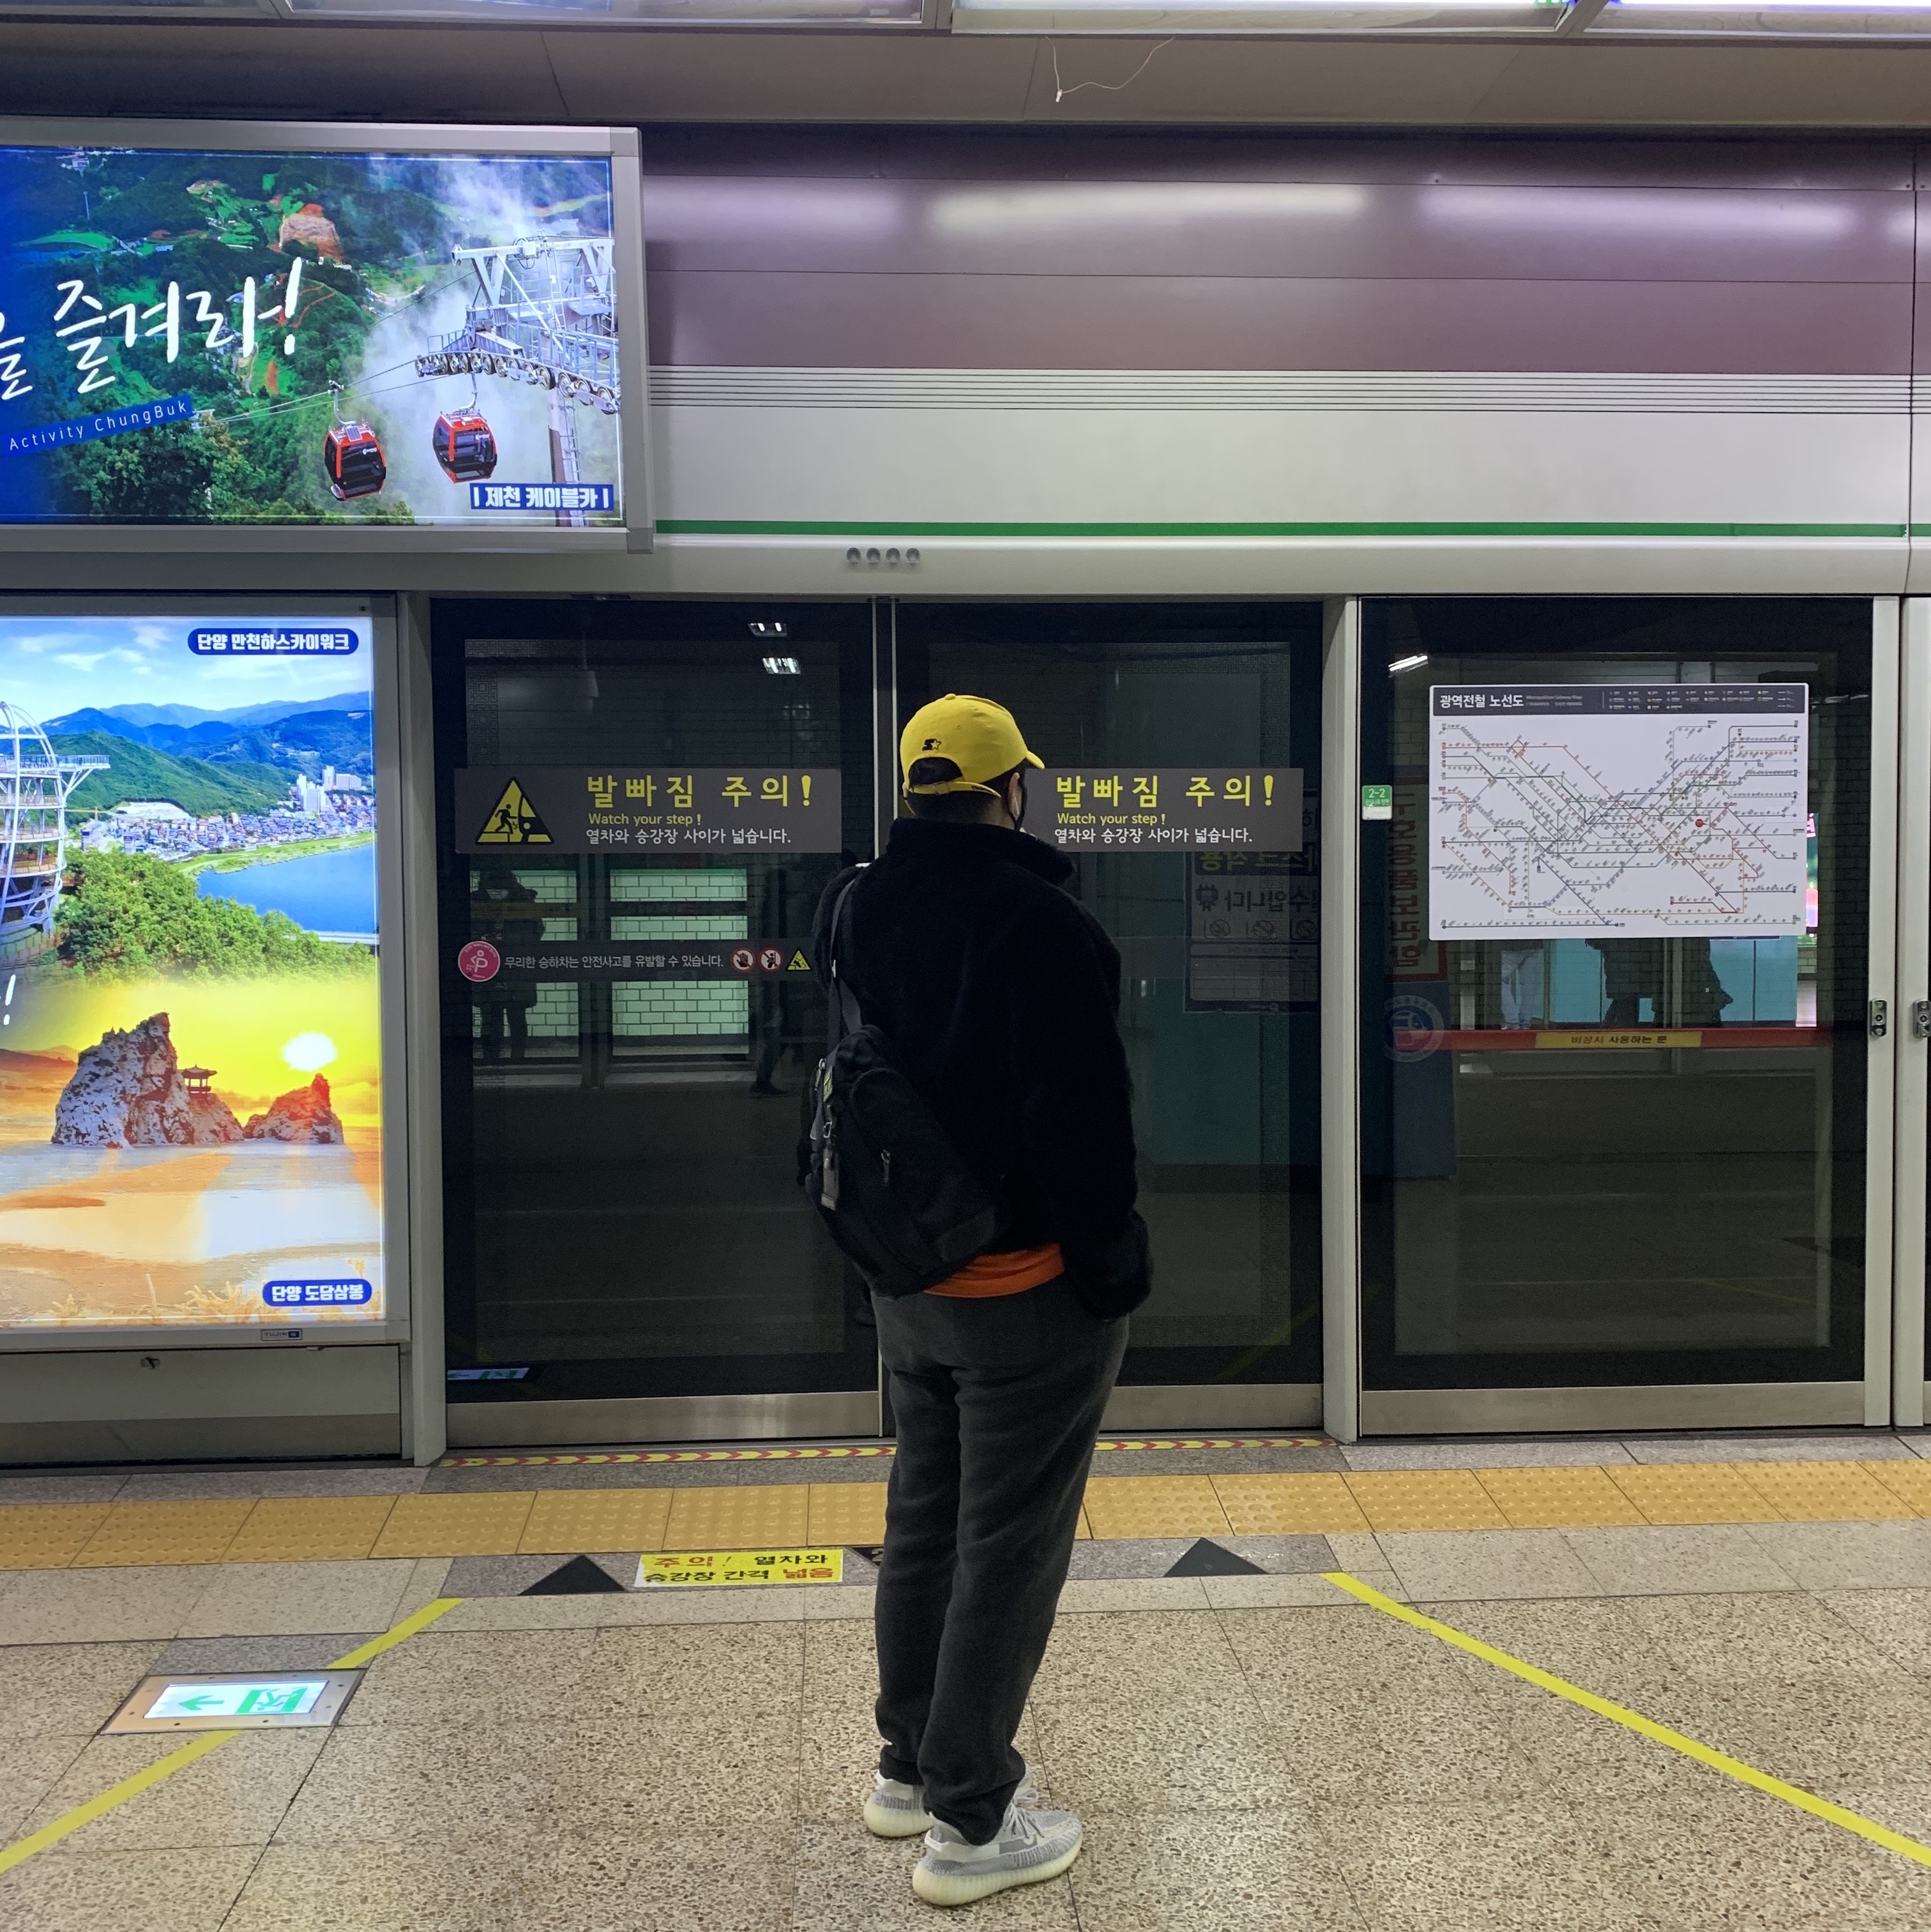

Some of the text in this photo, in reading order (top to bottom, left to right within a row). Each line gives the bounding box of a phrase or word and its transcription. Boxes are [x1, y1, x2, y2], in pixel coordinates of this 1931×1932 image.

[54, 256, 303, 394] 즐겨라!
[9, 400, 187, 451] Activity ChungBuk
[485, 485, 598, 508] 제천 케이블카
[197, 632, 350, 650] 단양 만천하스카이워크
[1440, 694, 1524, 708] 광역전철 노선도
[587, 775, 693, 808] 발빠짐
[1056, 775, 1158, 808] 발빠짐
[1368, 787, 1386, 798] 2-2
[588, 813, 629, 825] Watch
[633, 815, 662, 826] your
[1057, 812, 1096, 825] Watch
[1100, 815, 1128, 826] your
[586, 828, 791, 844] 열차와 승강장 사이가 넓습니다.
[1054, 828, 1253, 844] 열차와 승강장 사이가 넓습니다.
[504, 955, 723, 969] 무리한 승하차는 안전사고를 유발할 수 있습니다.
[1571, 1035, 1604, 1044] 비상시
[1609, 1035, 1652, 1044] 사용하는
[271, 1284, 364, 1302] 단양 도담삼봉
[754, 1554, 828, 1565] 열차와
[645, 1567, 834, 1583] 승강장 간격 넓음
